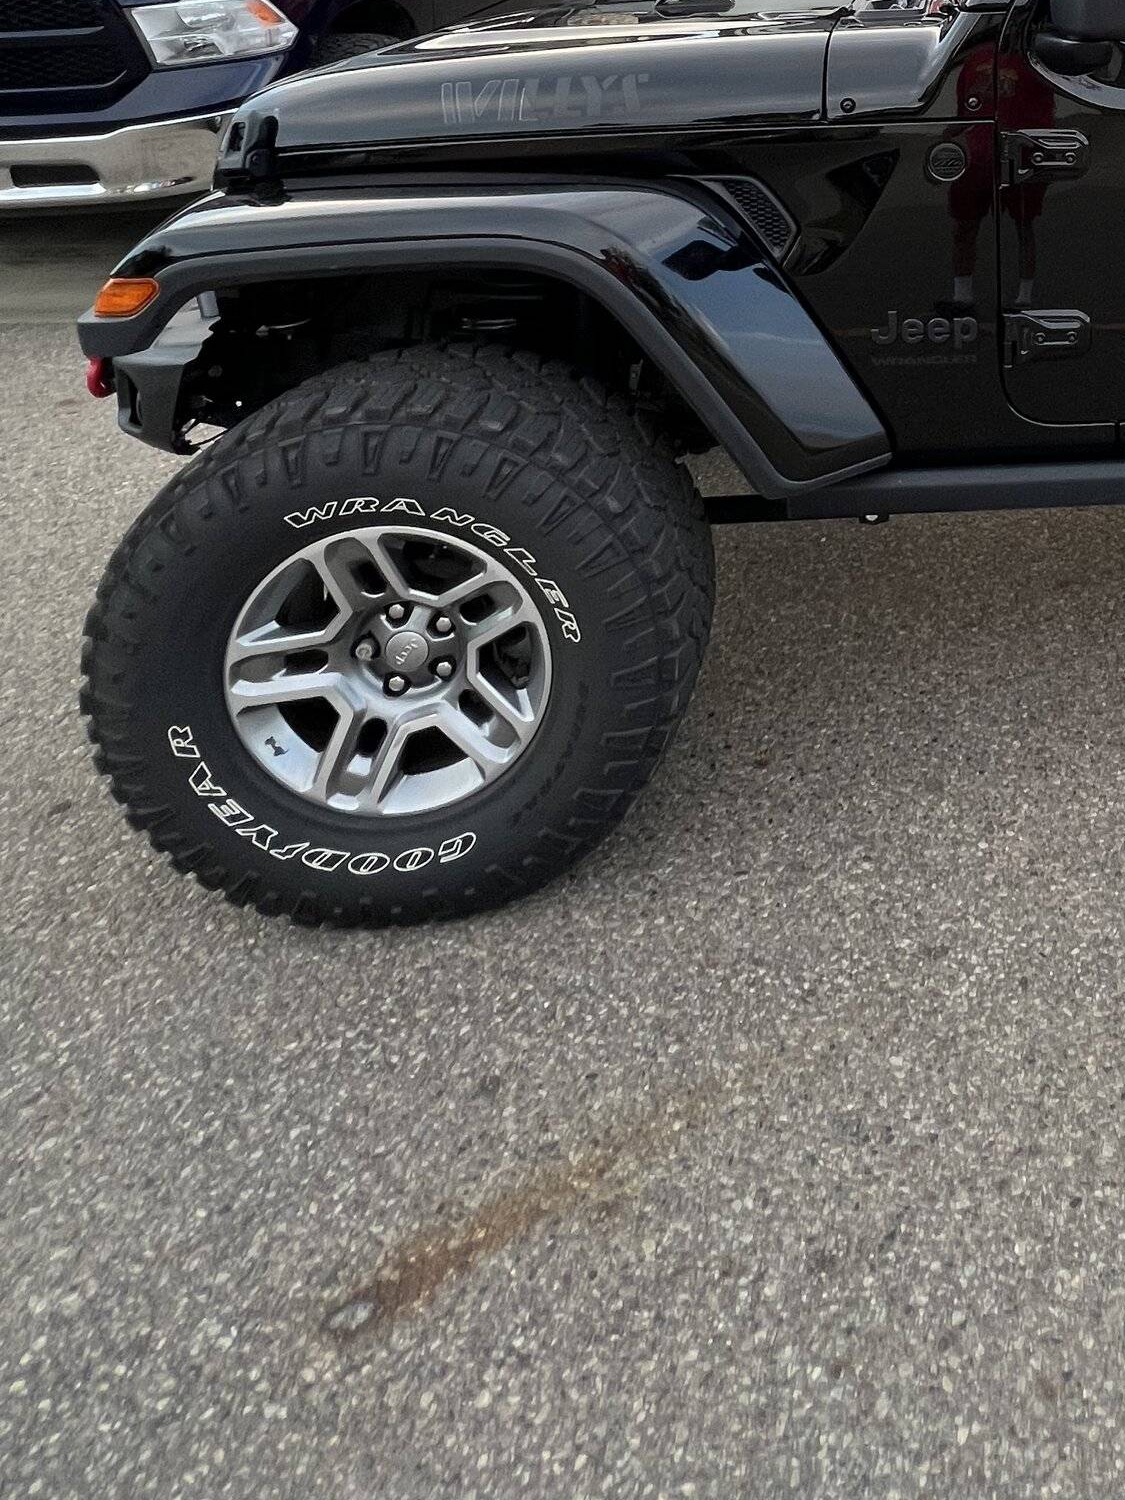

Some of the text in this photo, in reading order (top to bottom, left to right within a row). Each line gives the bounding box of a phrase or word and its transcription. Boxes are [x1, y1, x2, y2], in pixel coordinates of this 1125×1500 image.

[870, 310, 978, 349] Jeep
[284, 497, 582, 643] WRANGLER
[167, 725, 477, 875] GOODYEAR
